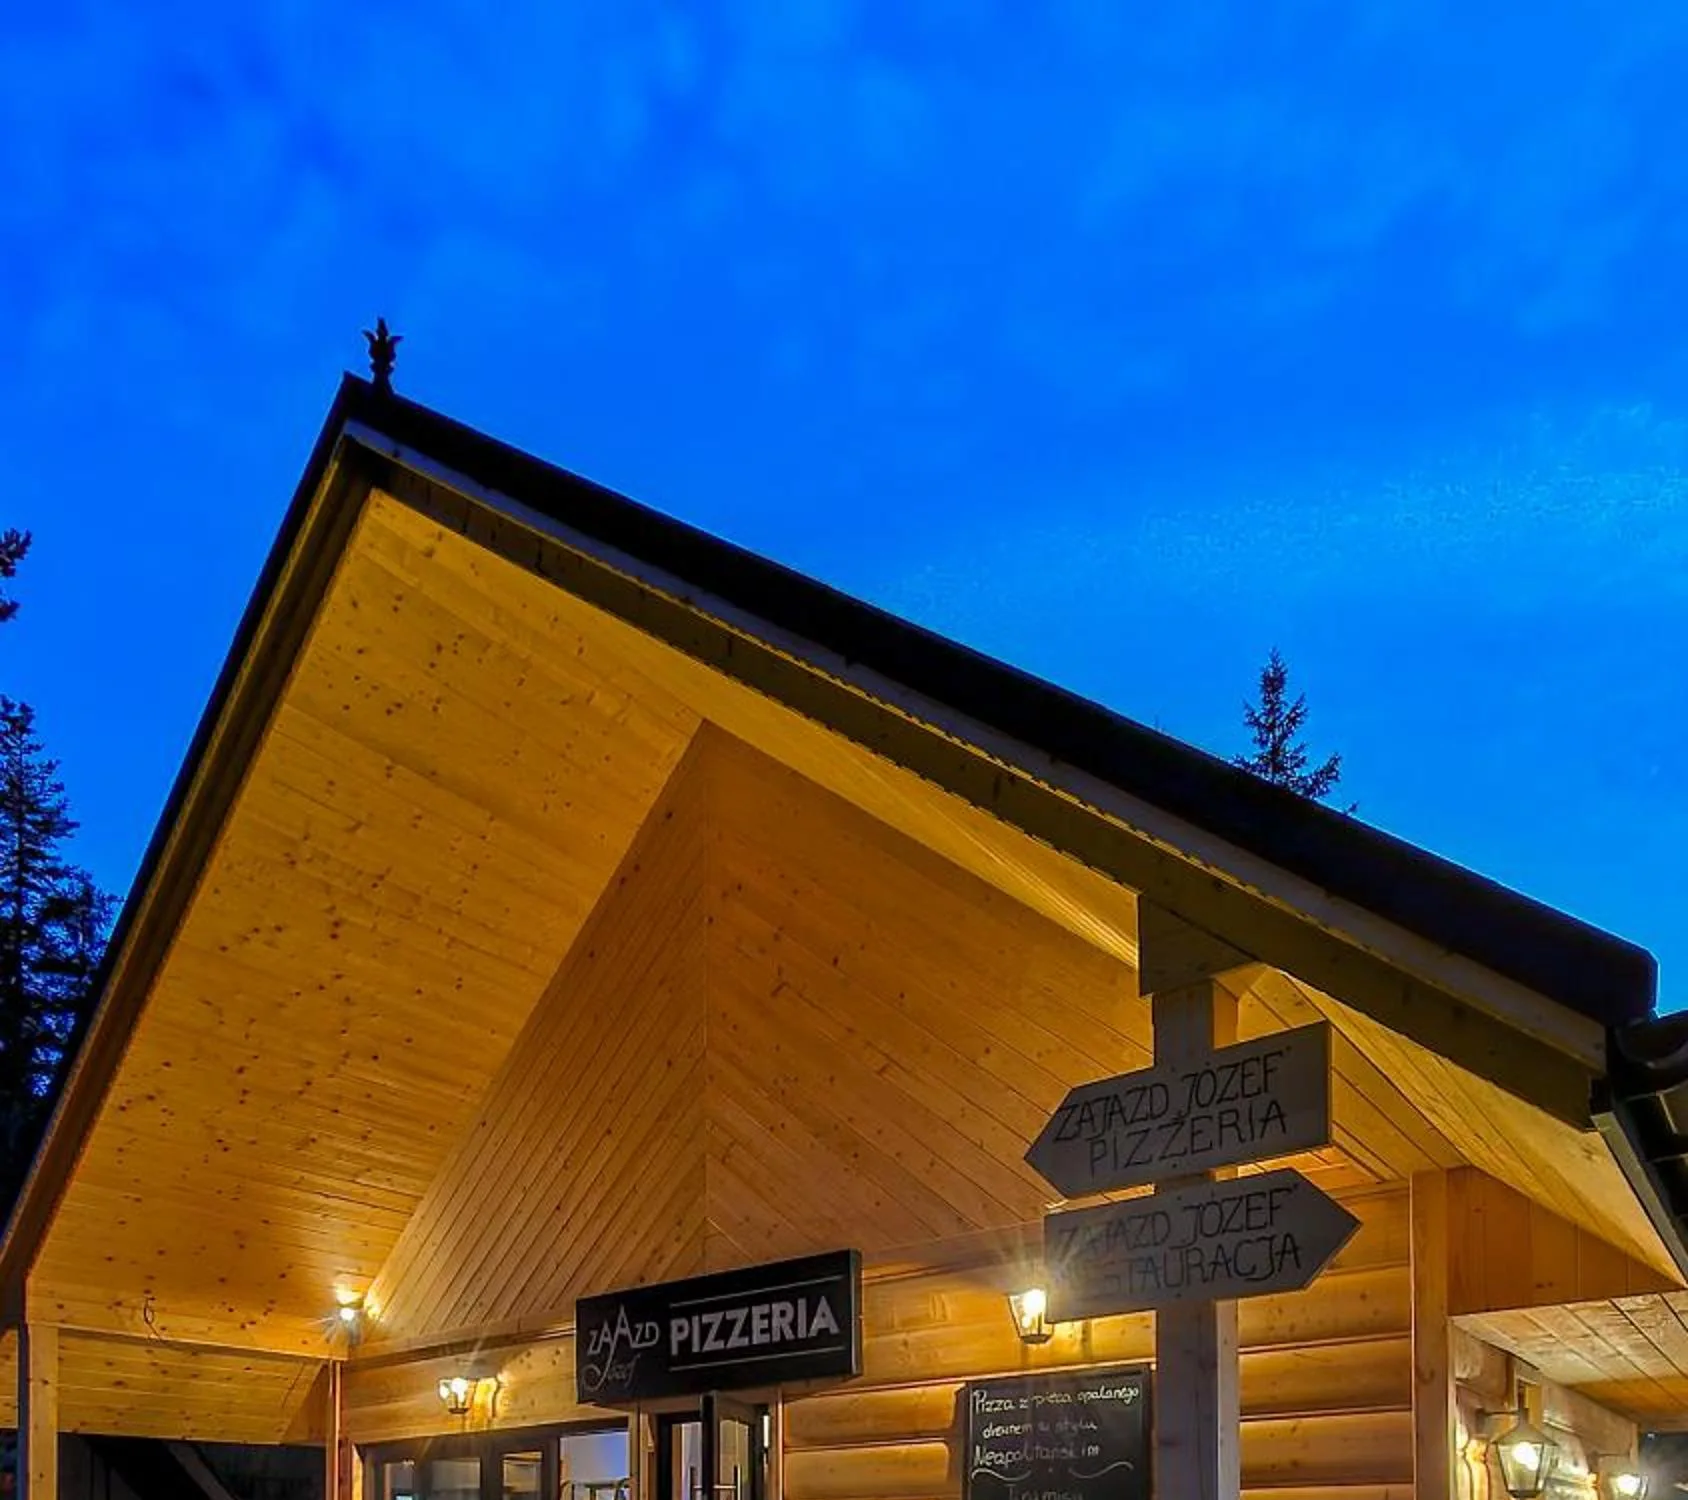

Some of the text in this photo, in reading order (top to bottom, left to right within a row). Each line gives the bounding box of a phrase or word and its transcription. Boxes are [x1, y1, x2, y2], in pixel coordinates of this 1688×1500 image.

[1053, 1082, 1170, 1143] ZAJAZD
[1087, 1099, 1288, 1180] PIZZERIA
[1060, 1233, 1301, 1297] STAURACJA
[669, 1296, 840, 1356] PIZZERIA
[973, 1389, 1016, 1414] Pizza
